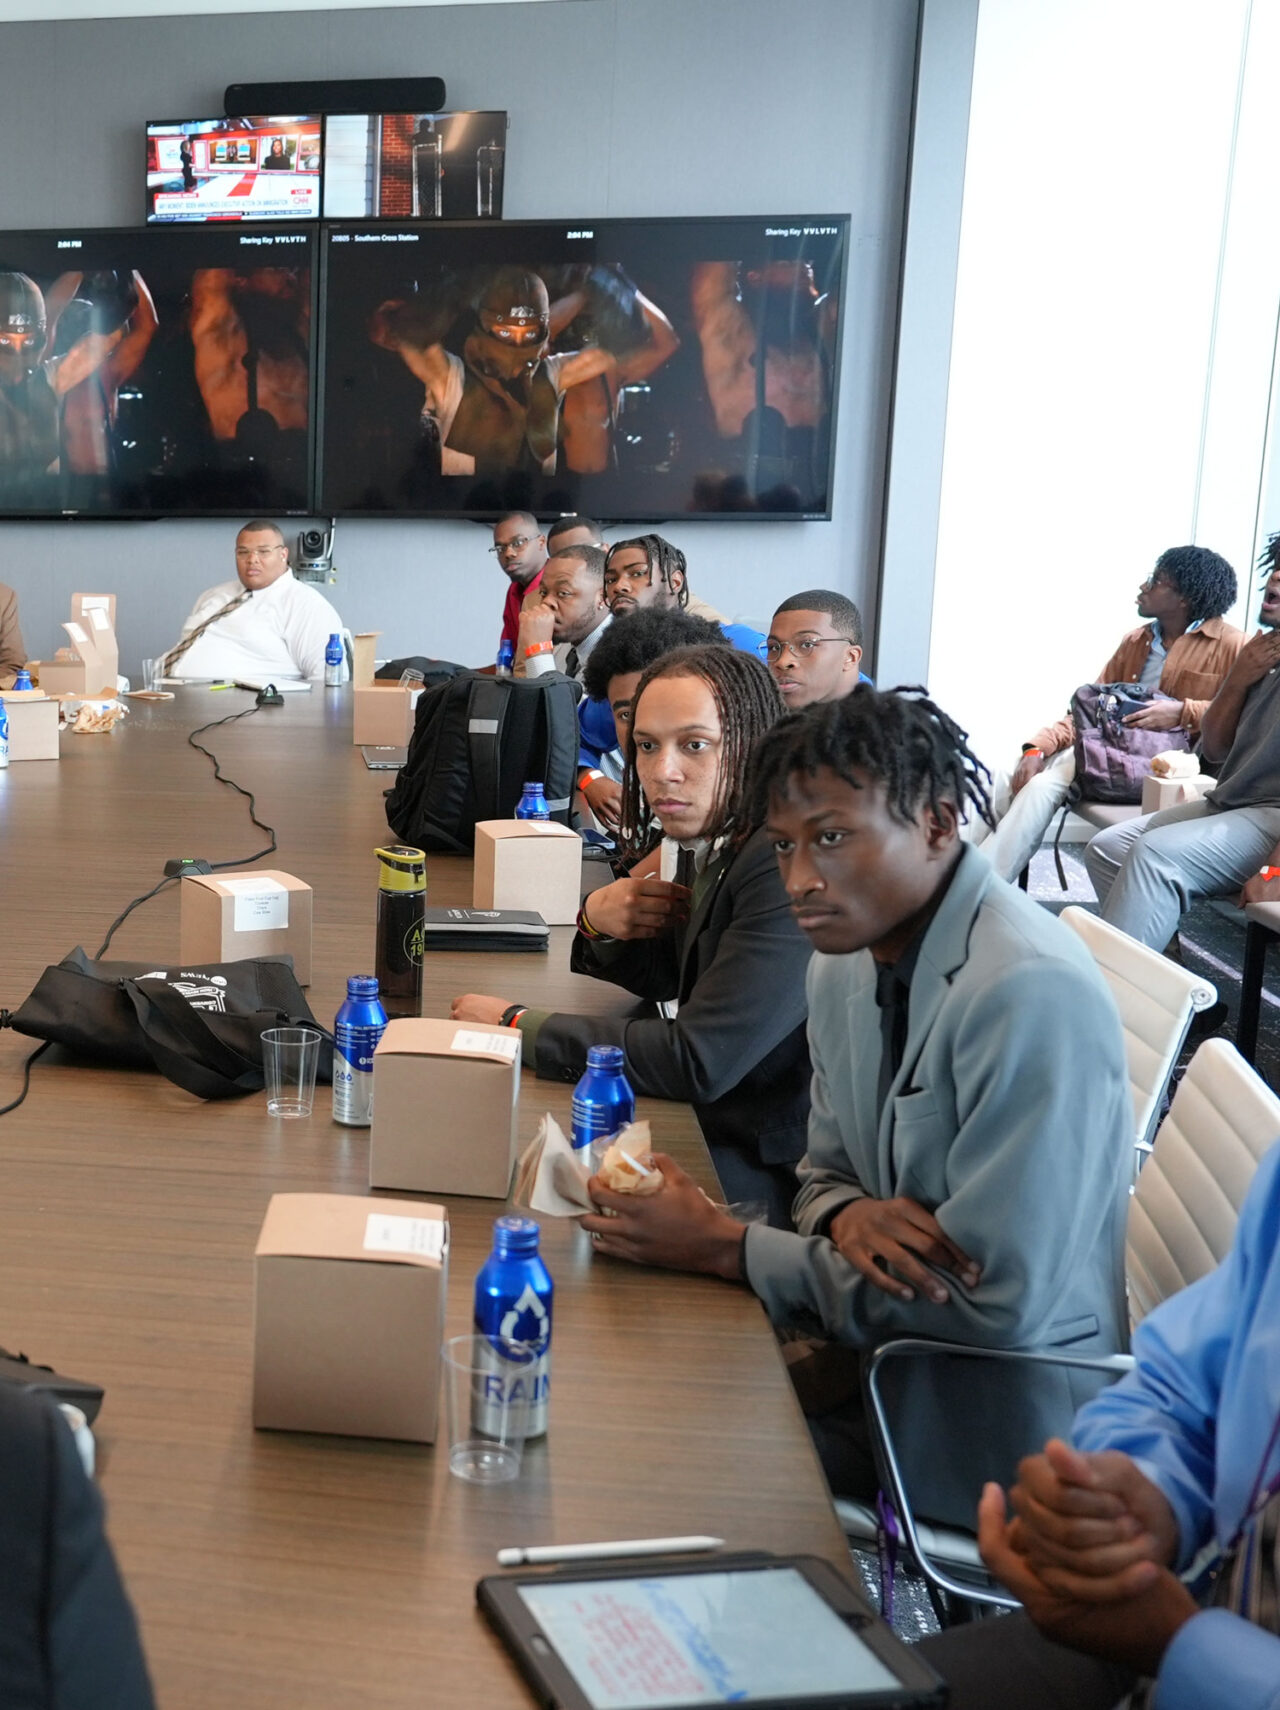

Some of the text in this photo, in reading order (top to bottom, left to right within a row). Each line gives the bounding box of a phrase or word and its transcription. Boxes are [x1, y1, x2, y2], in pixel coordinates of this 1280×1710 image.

[293, 197, 308, 205] CNN
[581, 231, 593, 239] PM
[765, 227, 838, 237] Sharing Key VVLVTH
[240, 236, 261, 246] Sharing
[261, 236, 273, 245] Key
[354, 234, 380, 242] Southern
[381, 233, 397, 241] Cross
[397, 233, 419, 241] Station
[71, 240, 82, 248] PM
